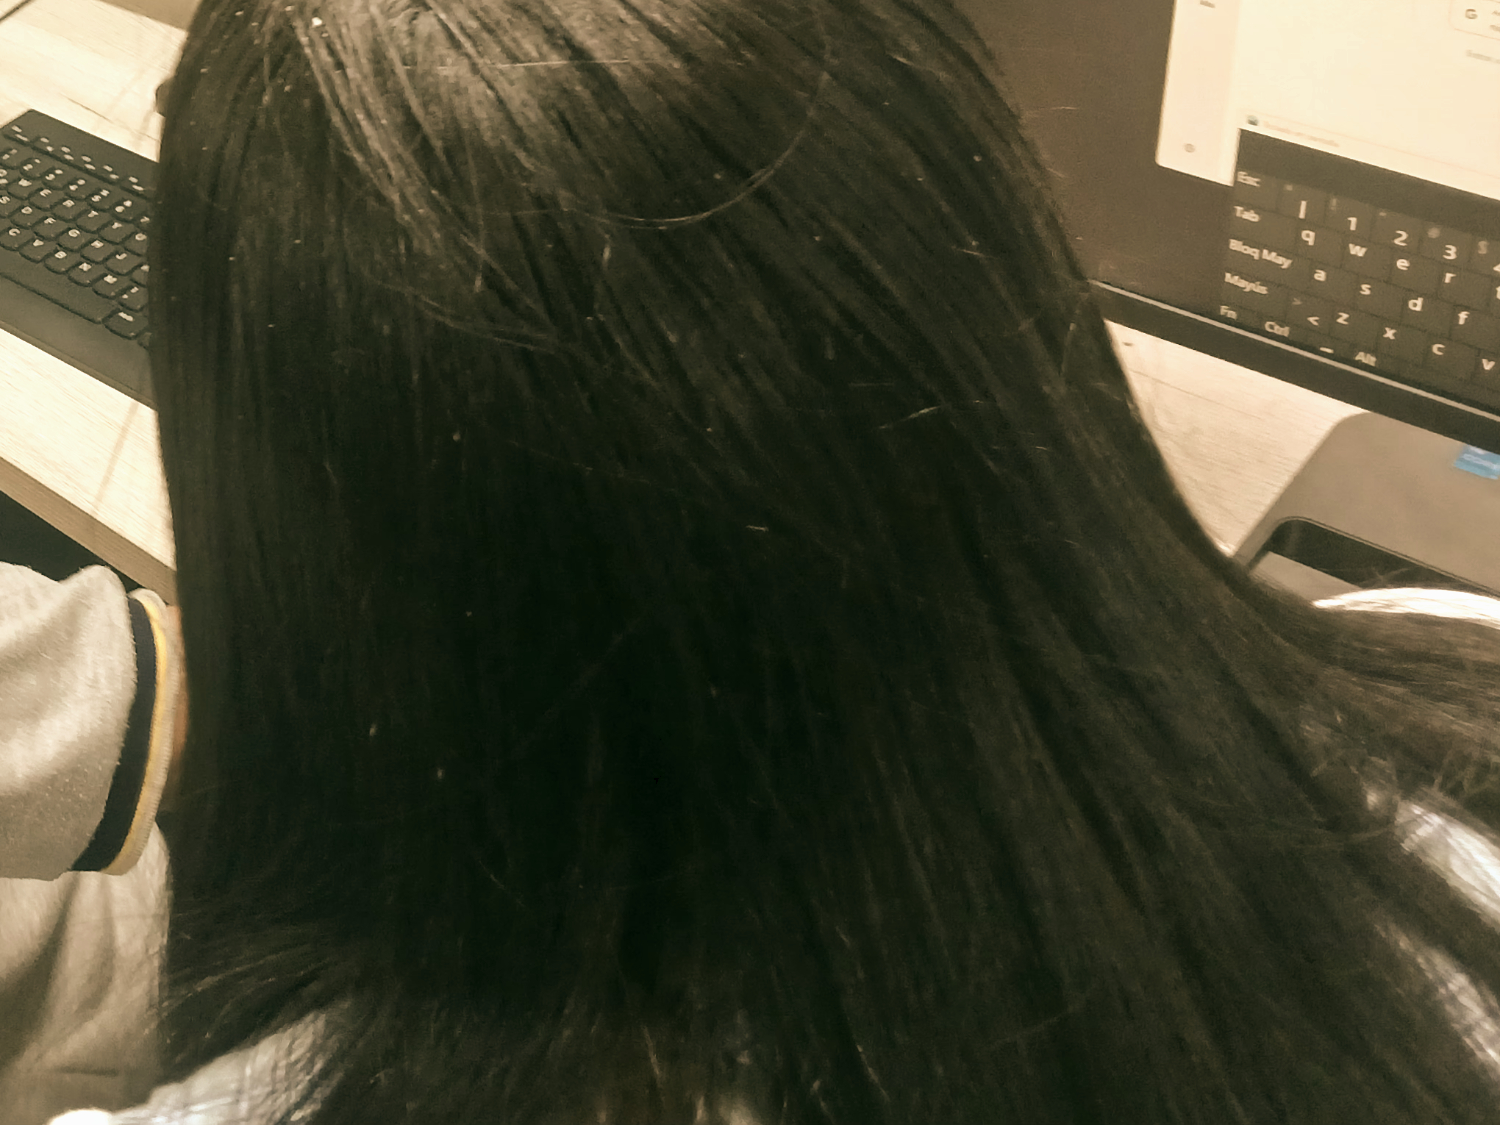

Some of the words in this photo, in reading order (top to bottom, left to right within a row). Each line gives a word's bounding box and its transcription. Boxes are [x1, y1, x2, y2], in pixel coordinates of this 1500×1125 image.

[1234, 205, 1260, 223] Tab
[1301, 229, 1316, 246] q
[1348, 243, 1368, 257] w
[1396, 258, 1411, 271] e
[1444, 272, 1457, 284] r
[1237, 171, 1261, 187] Esc
[1347, 217, 1357, 231] 1
[1393, 230, 1409, 246] 2
[1443, 244, 1457, 260] 3
[1229, 238, 1260, 260] Bloq
[1262, 249, 1293, 269] May
[1314, 269, 1326, 282] a
[1360, 284, 1371, 295] s
[1408, 297, 1424, 312] d
[1458, 311, 1470, 325] f
[1220, 305, 1238, 320] Fn
[1264, 321, 1290, 337] Ctrl
[1354, 351, 1377, 367] Alt
[1382, 327, 1397, 340] x
[1432, 343, 1445, 356] c
[1482, 358, 1496, 371] v
